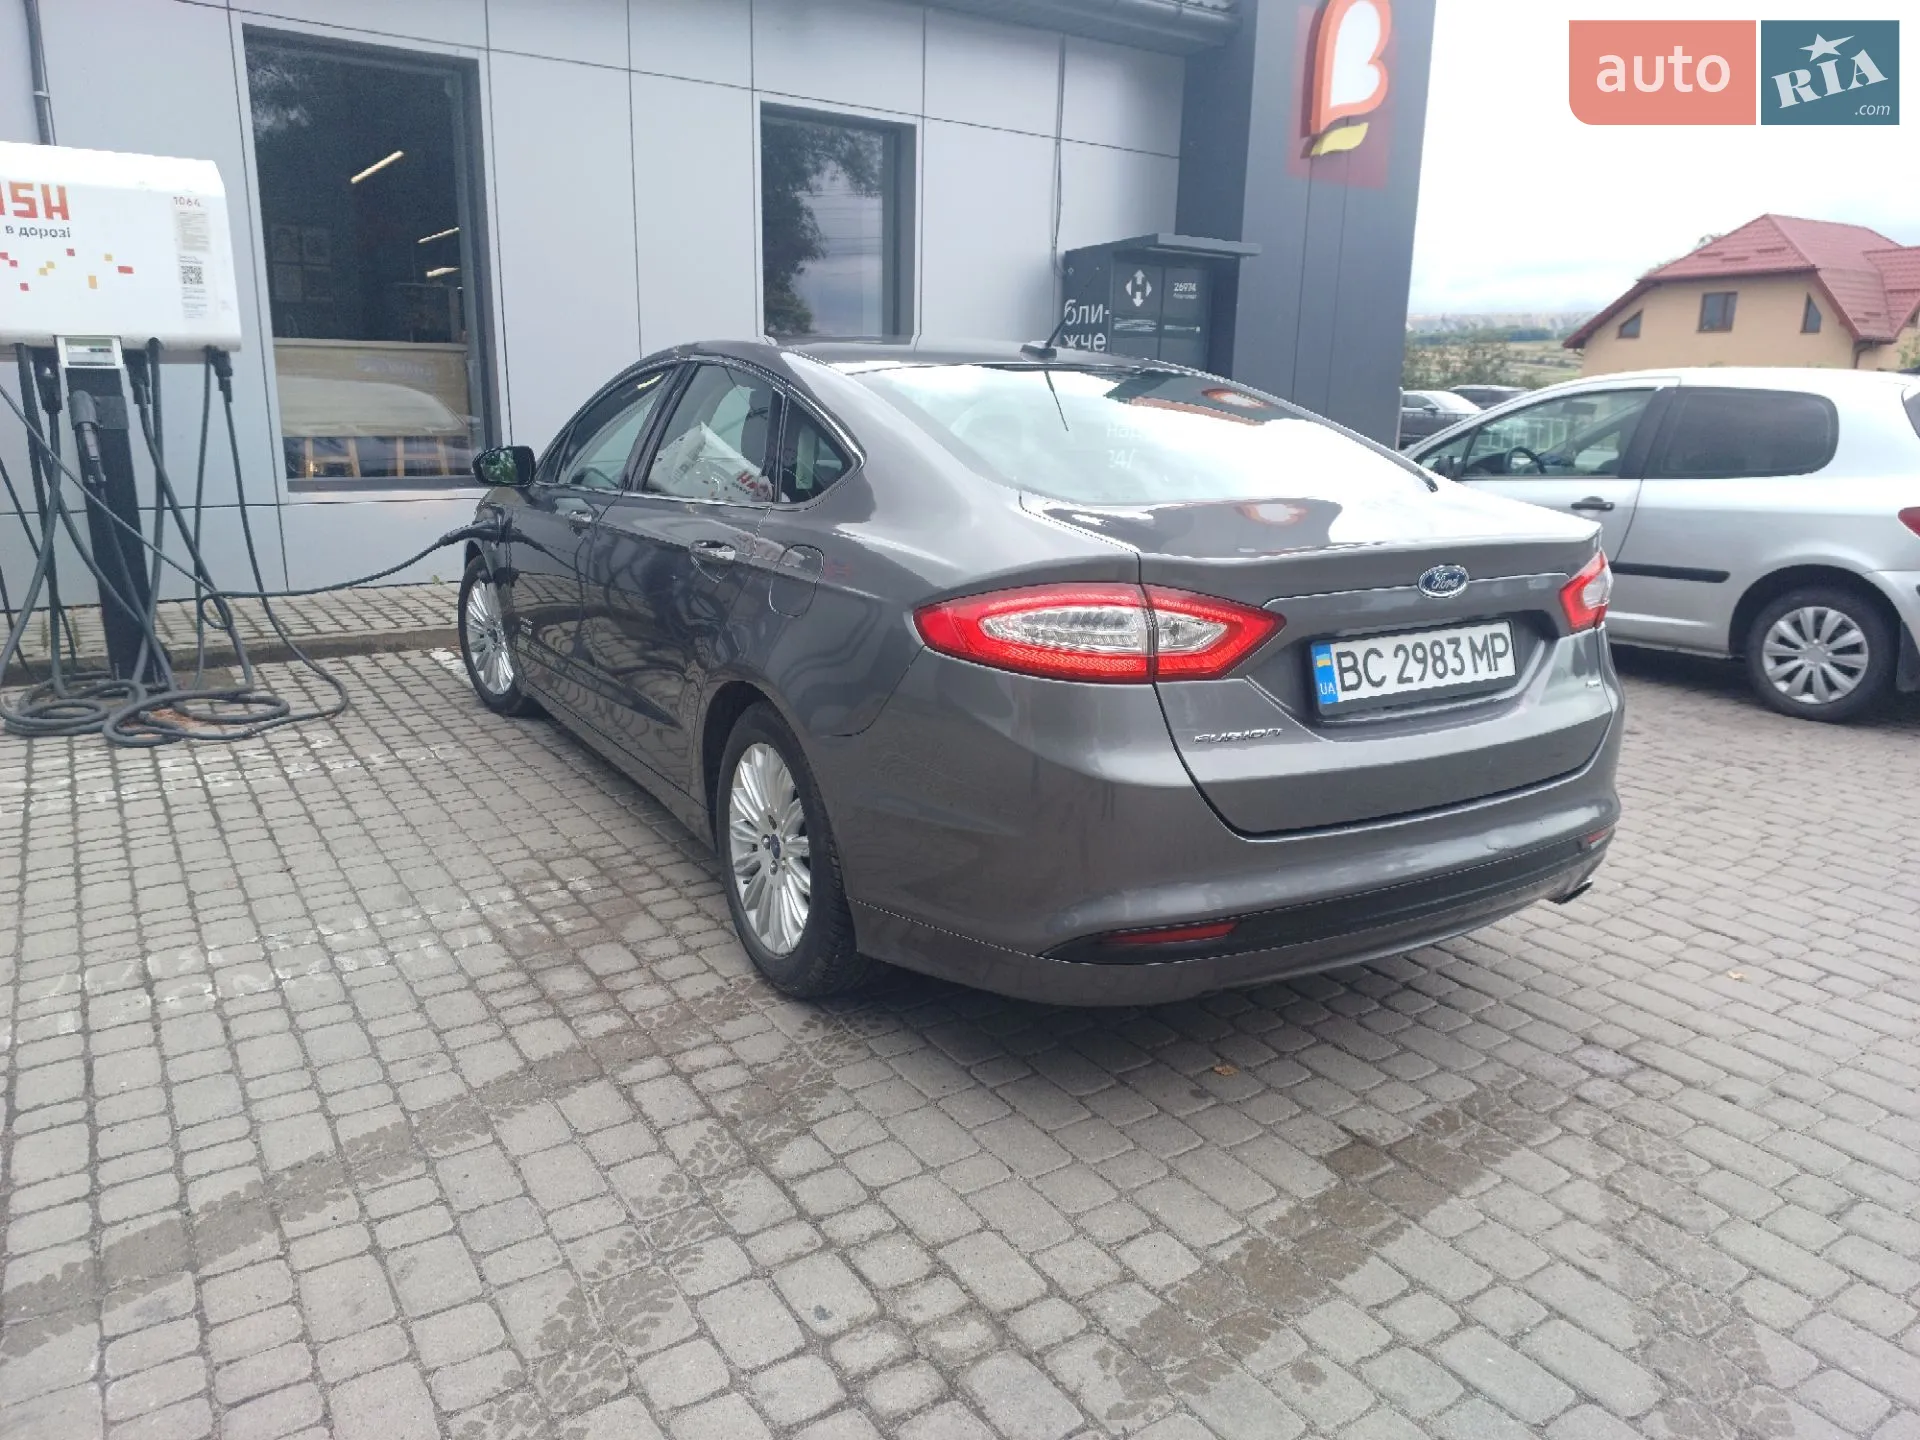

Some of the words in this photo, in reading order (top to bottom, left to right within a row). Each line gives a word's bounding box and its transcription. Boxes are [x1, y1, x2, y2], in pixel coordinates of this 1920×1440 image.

[0, 181, 70, 221] SH
[5, 225, 15, 236] в
[19, 226, 72, 239] дорозі
[1064, 298, 1111, 326] бли-
[1431, 572, 1460, 590] Ford
[1320, 682, 1336, 695] UA
[1335, 647, 1388, 693] BC
[1396, 637, 1467, 685] 2983
[1471, 631, 1511, 675] MP
[1193, 727, 1284, 743] FUSION
